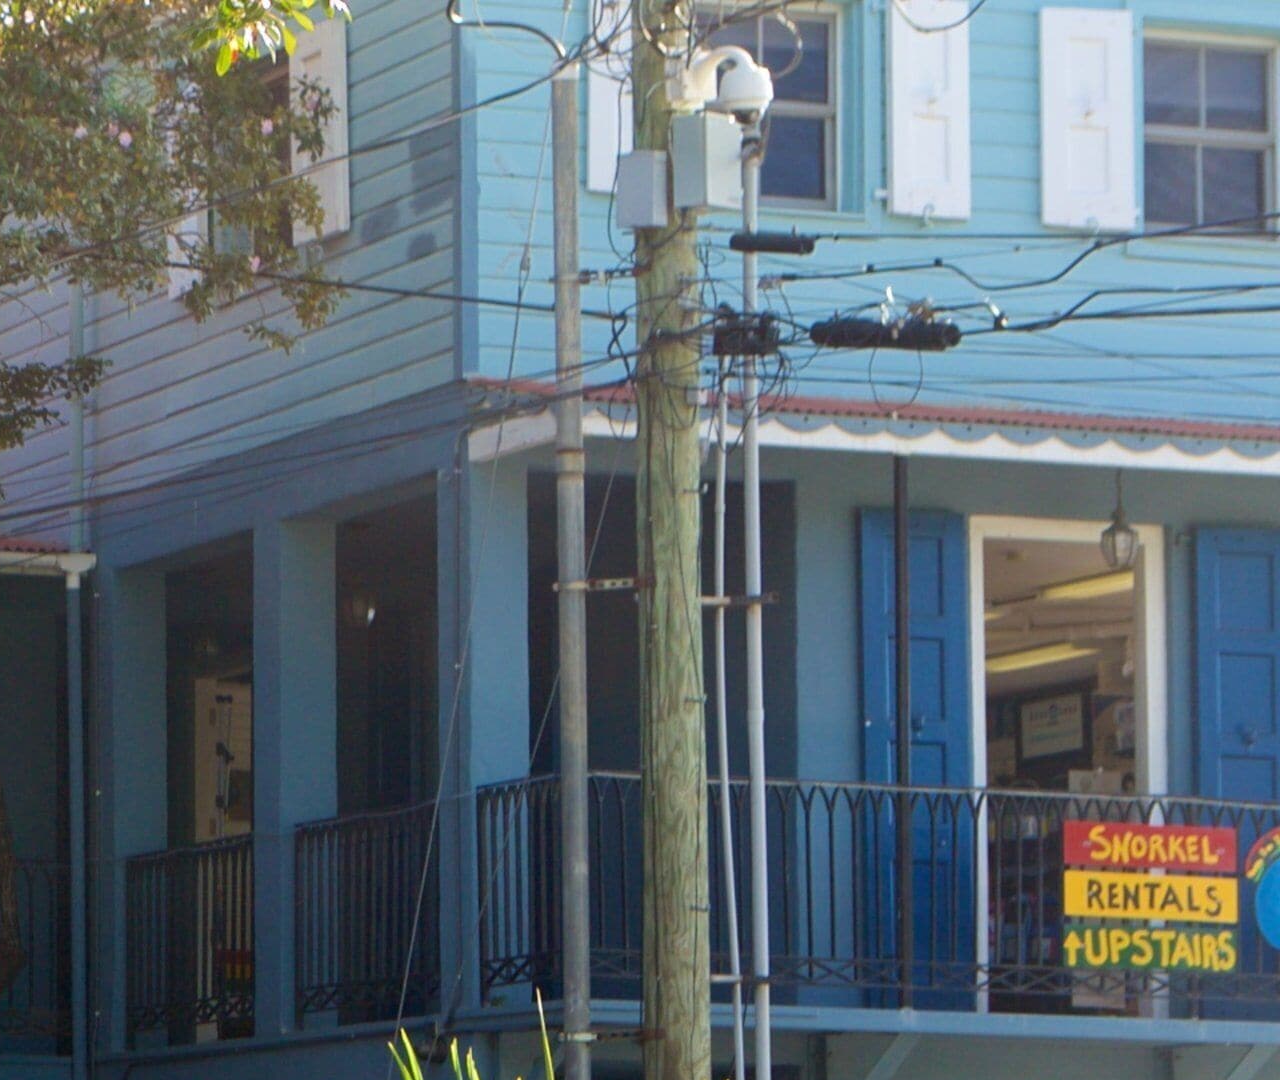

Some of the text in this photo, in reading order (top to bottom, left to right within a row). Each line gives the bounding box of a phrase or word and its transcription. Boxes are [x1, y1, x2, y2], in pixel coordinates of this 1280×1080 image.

[1089, 825, 1219, 864] SNORKEL
[1086, 879, 1223, 917] RENTALS
[1085, 928, 1236, 971] UPSTAIRS
